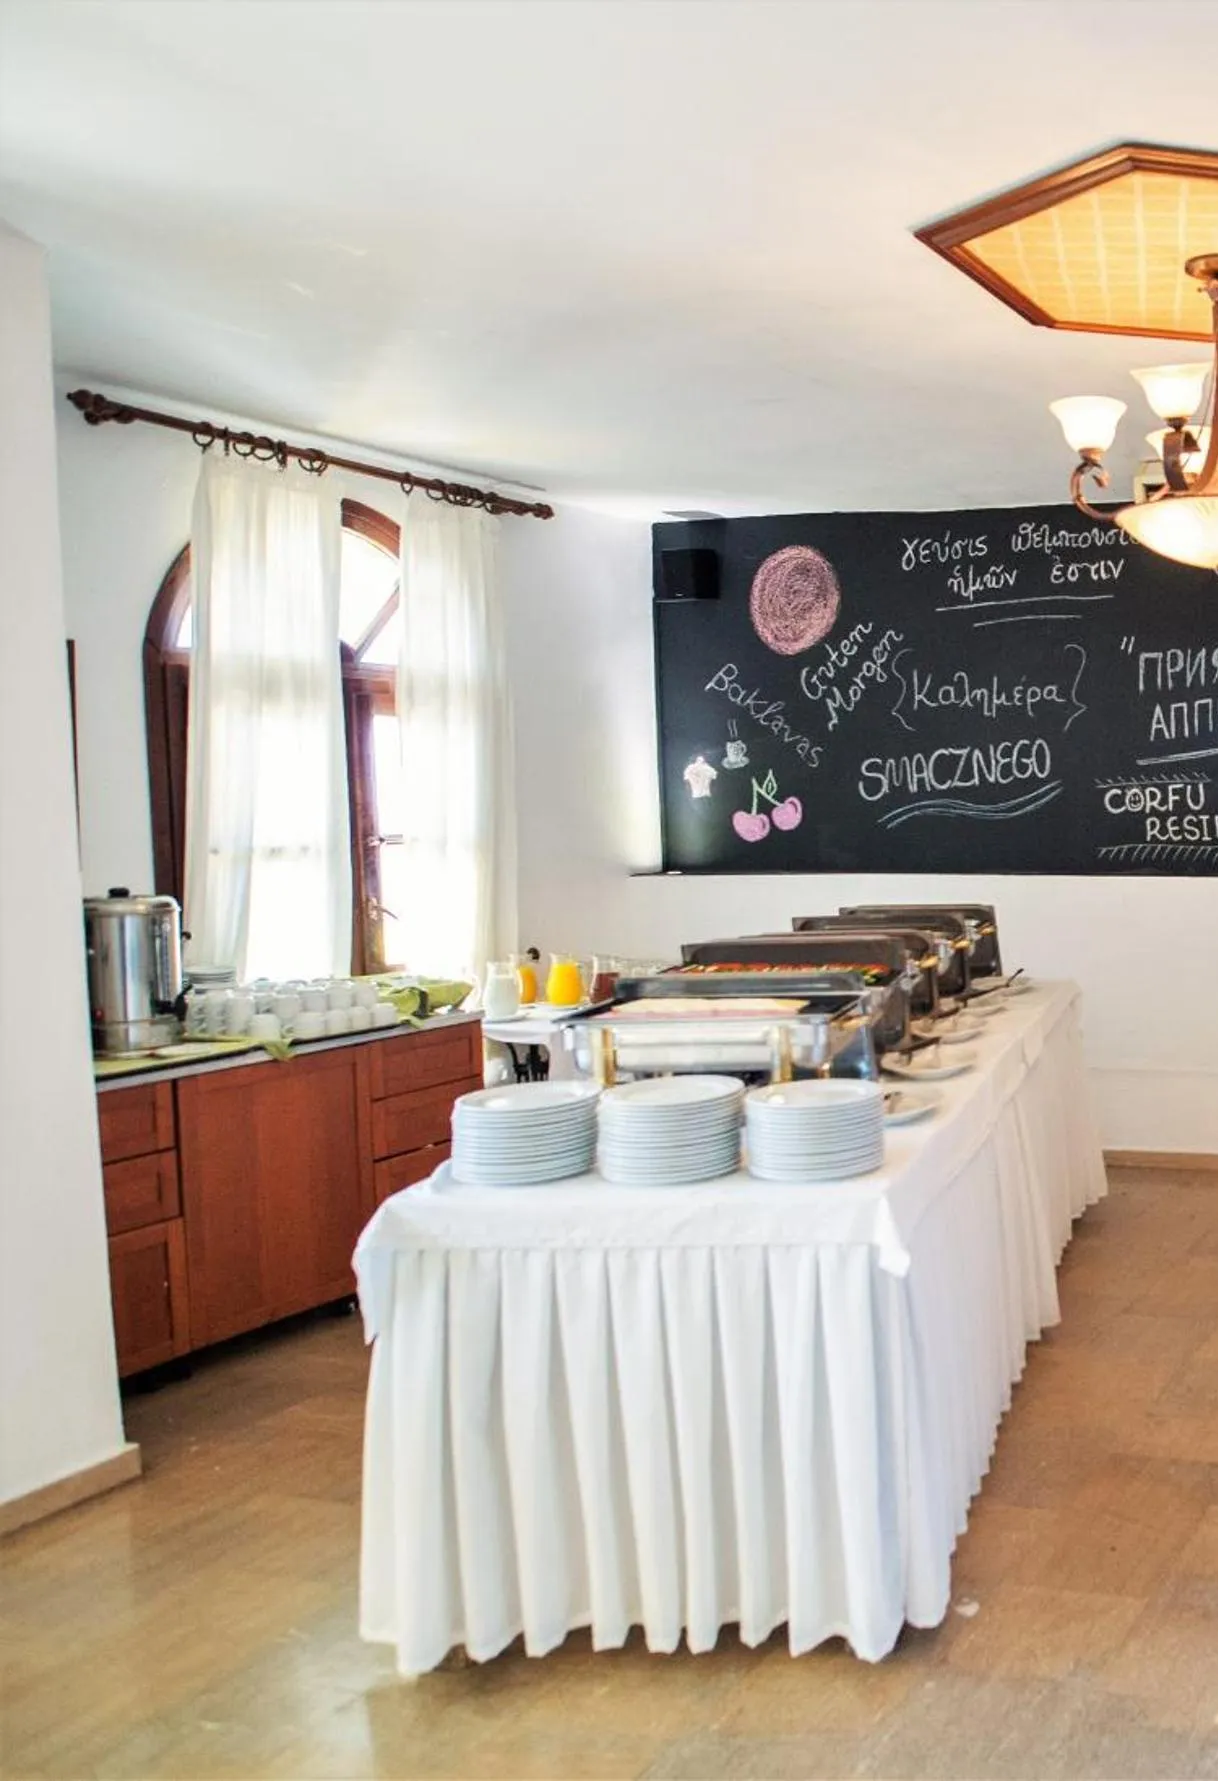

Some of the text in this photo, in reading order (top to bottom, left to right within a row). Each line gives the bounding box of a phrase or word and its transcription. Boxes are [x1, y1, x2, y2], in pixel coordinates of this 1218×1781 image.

[800, 622, 874, 700] Guten
[826, 629, 904, 732] Morgen
[857, 739, 1052, 802] SMACZNEGO
[1103, 783, 1207, 815] CORFU
